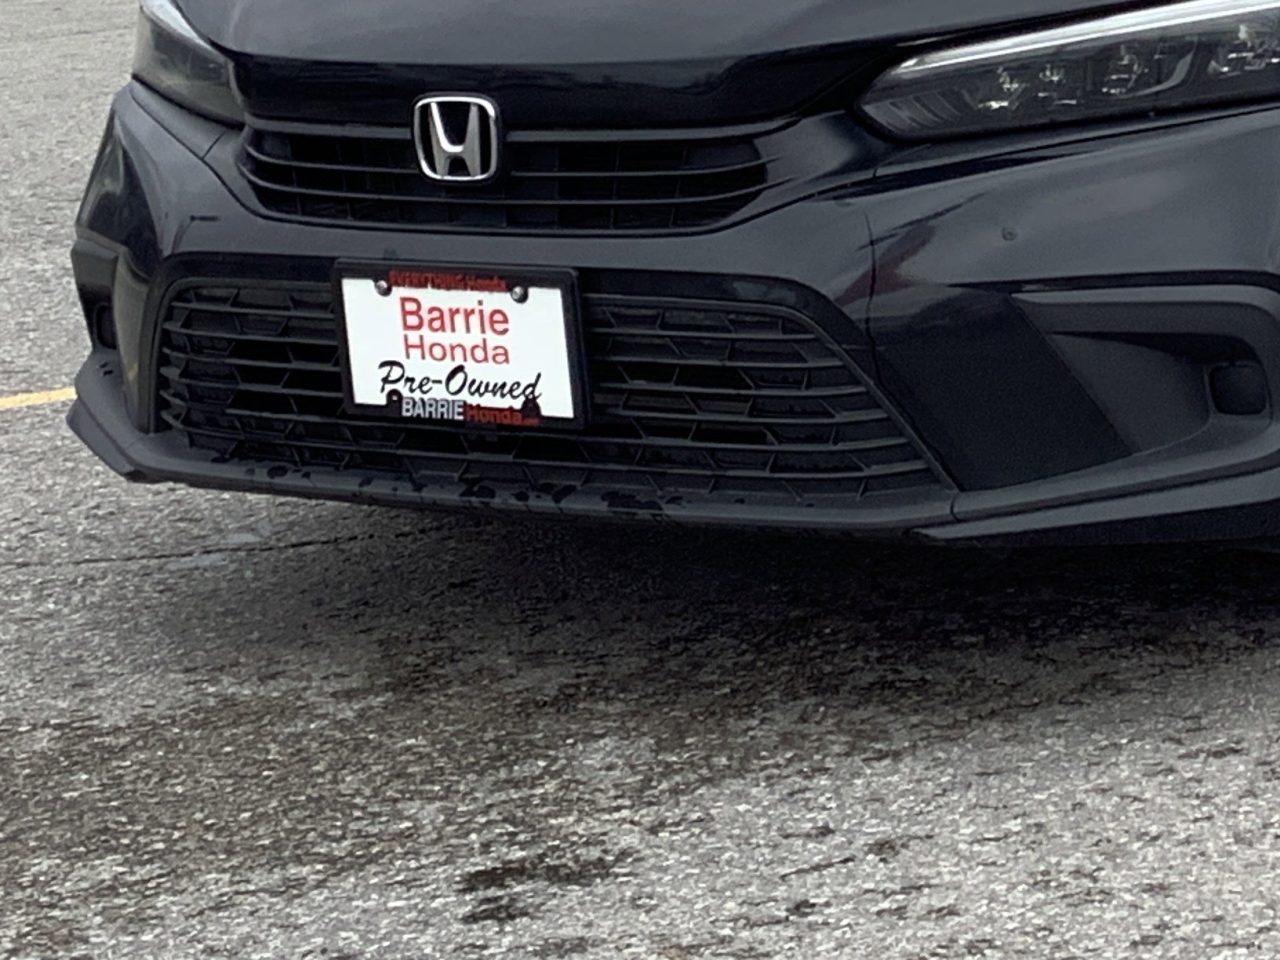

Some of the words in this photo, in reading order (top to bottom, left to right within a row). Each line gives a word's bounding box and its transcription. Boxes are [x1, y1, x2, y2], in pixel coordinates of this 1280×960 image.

[400, 296, 509, 336] Barrie
[404, 334, 510, 365] Honda
[377, 360, 542, 400] Pre-Owned
